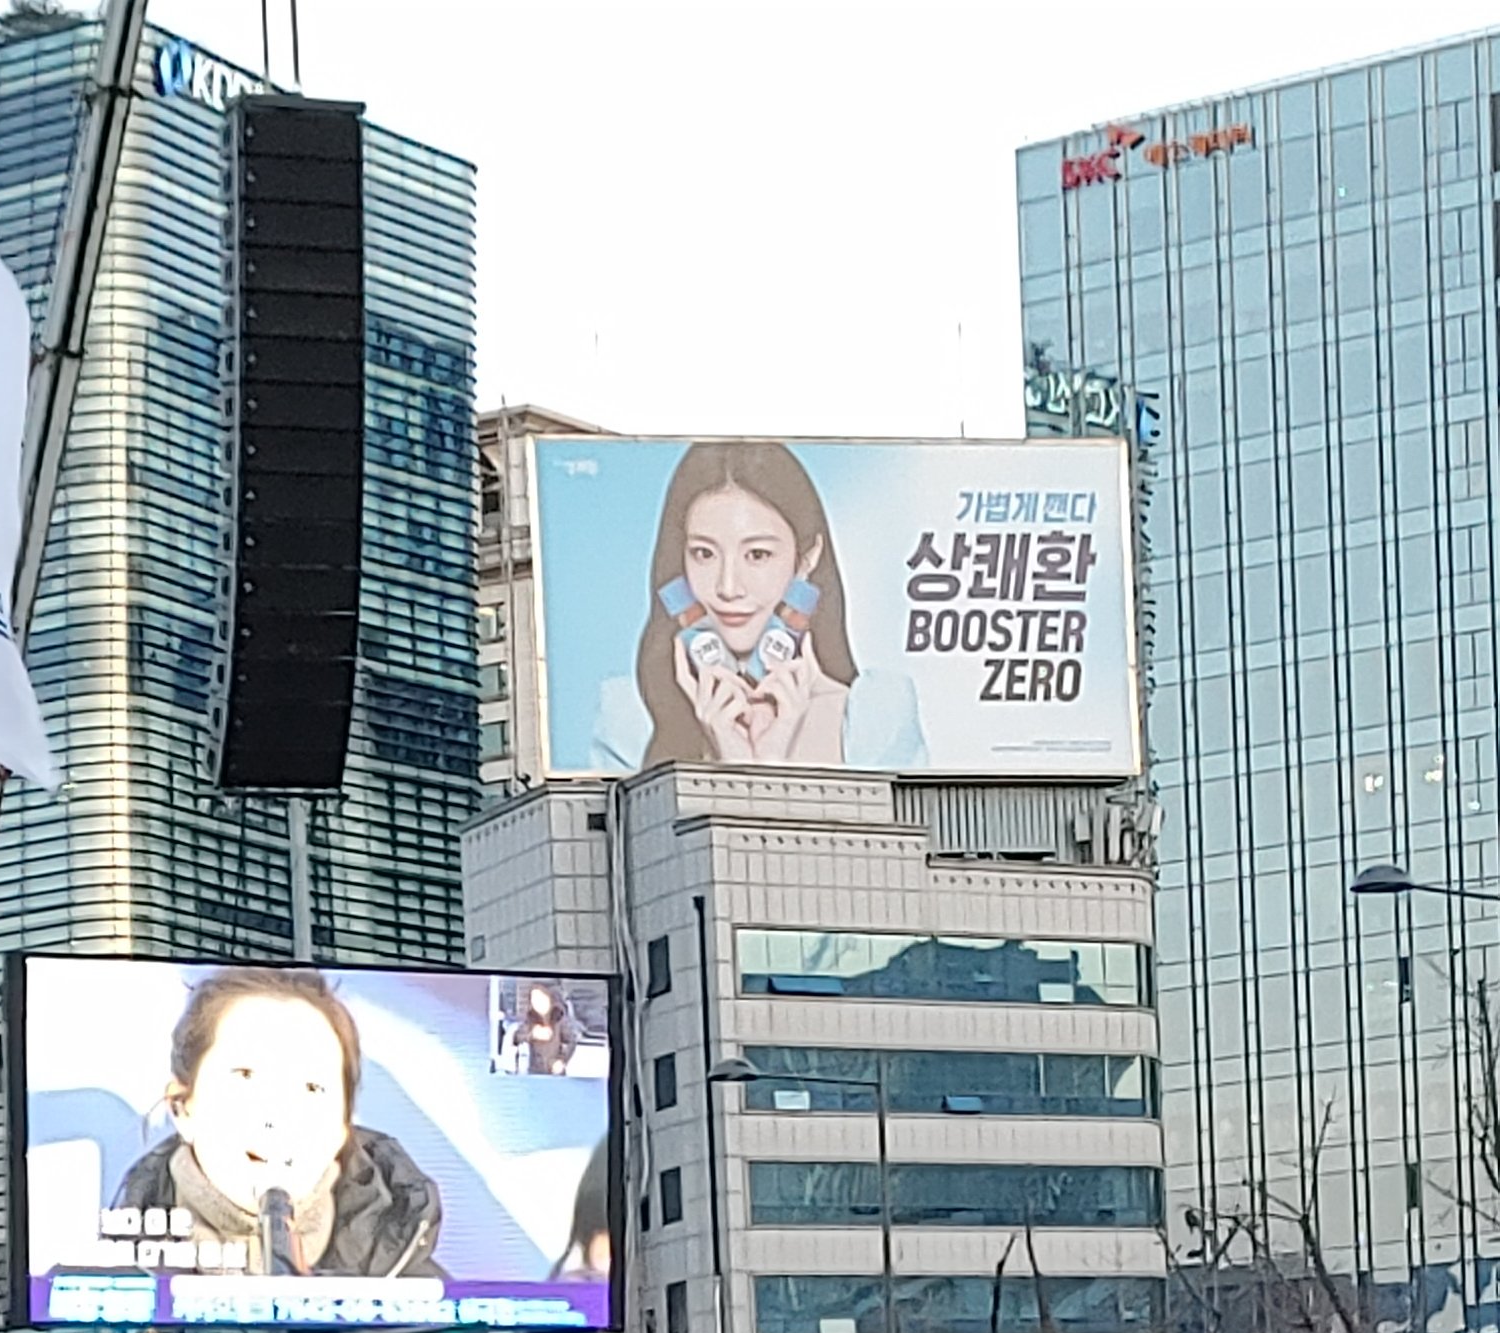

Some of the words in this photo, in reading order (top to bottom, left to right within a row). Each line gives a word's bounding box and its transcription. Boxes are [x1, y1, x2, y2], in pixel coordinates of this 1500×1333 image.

[956, 490, 1039, 523] 가볍게
[906, 530, 1097, 602] 상쾌환
[905, 609, 1087, 653] BOOSTER
[979, 659, 1081, 702] ZERO
